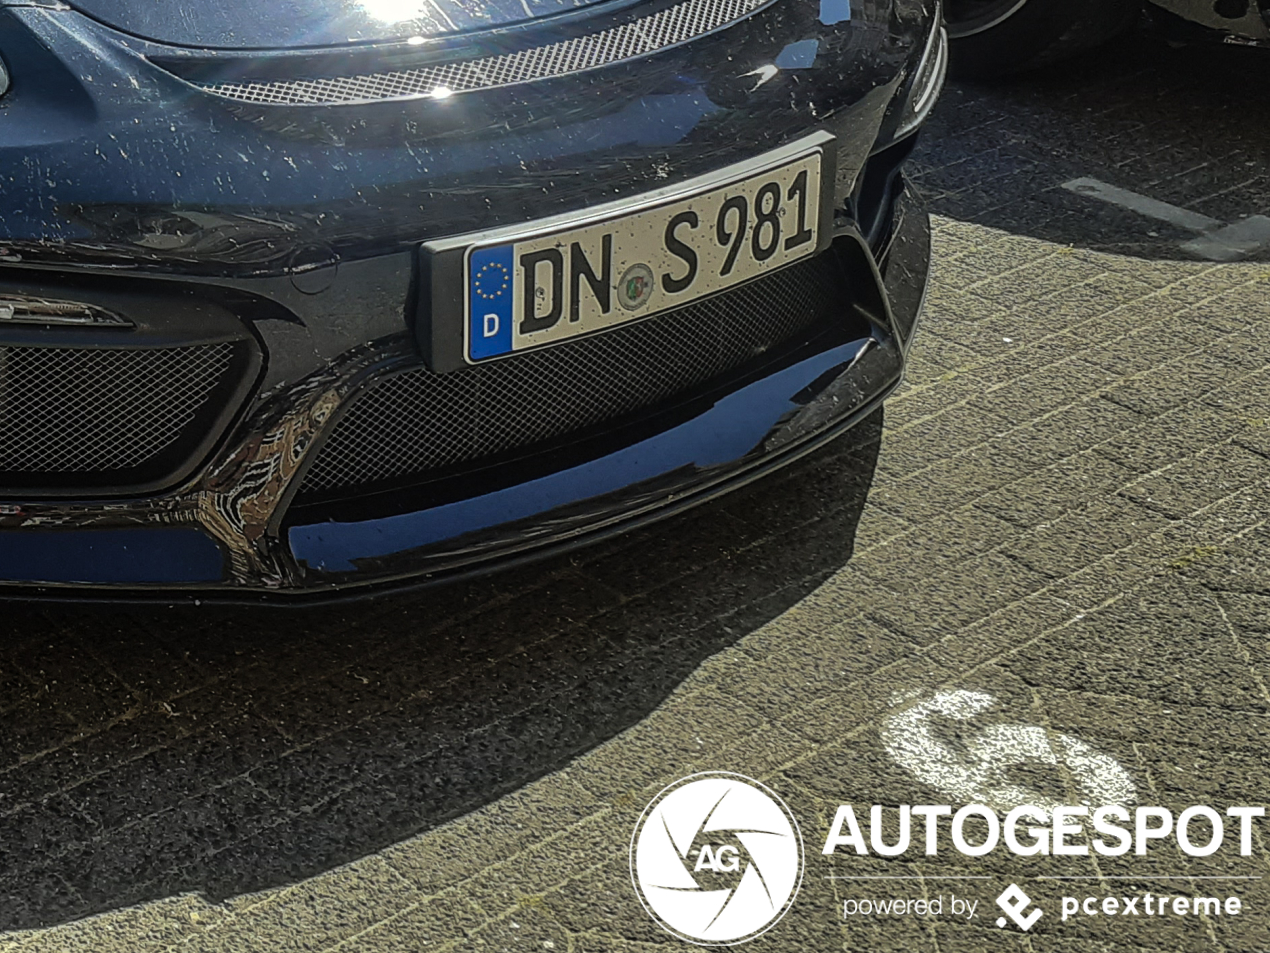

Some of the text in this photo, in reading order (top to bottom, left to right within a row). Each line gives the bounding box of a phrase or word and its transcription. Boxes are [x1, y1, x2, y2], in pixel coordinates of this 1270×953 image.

[519, 234, 612, 335] DN
[662, 211, 699, 294] S
[717, 170, 812, 277] 981
[483, 313, 500, 337] D
